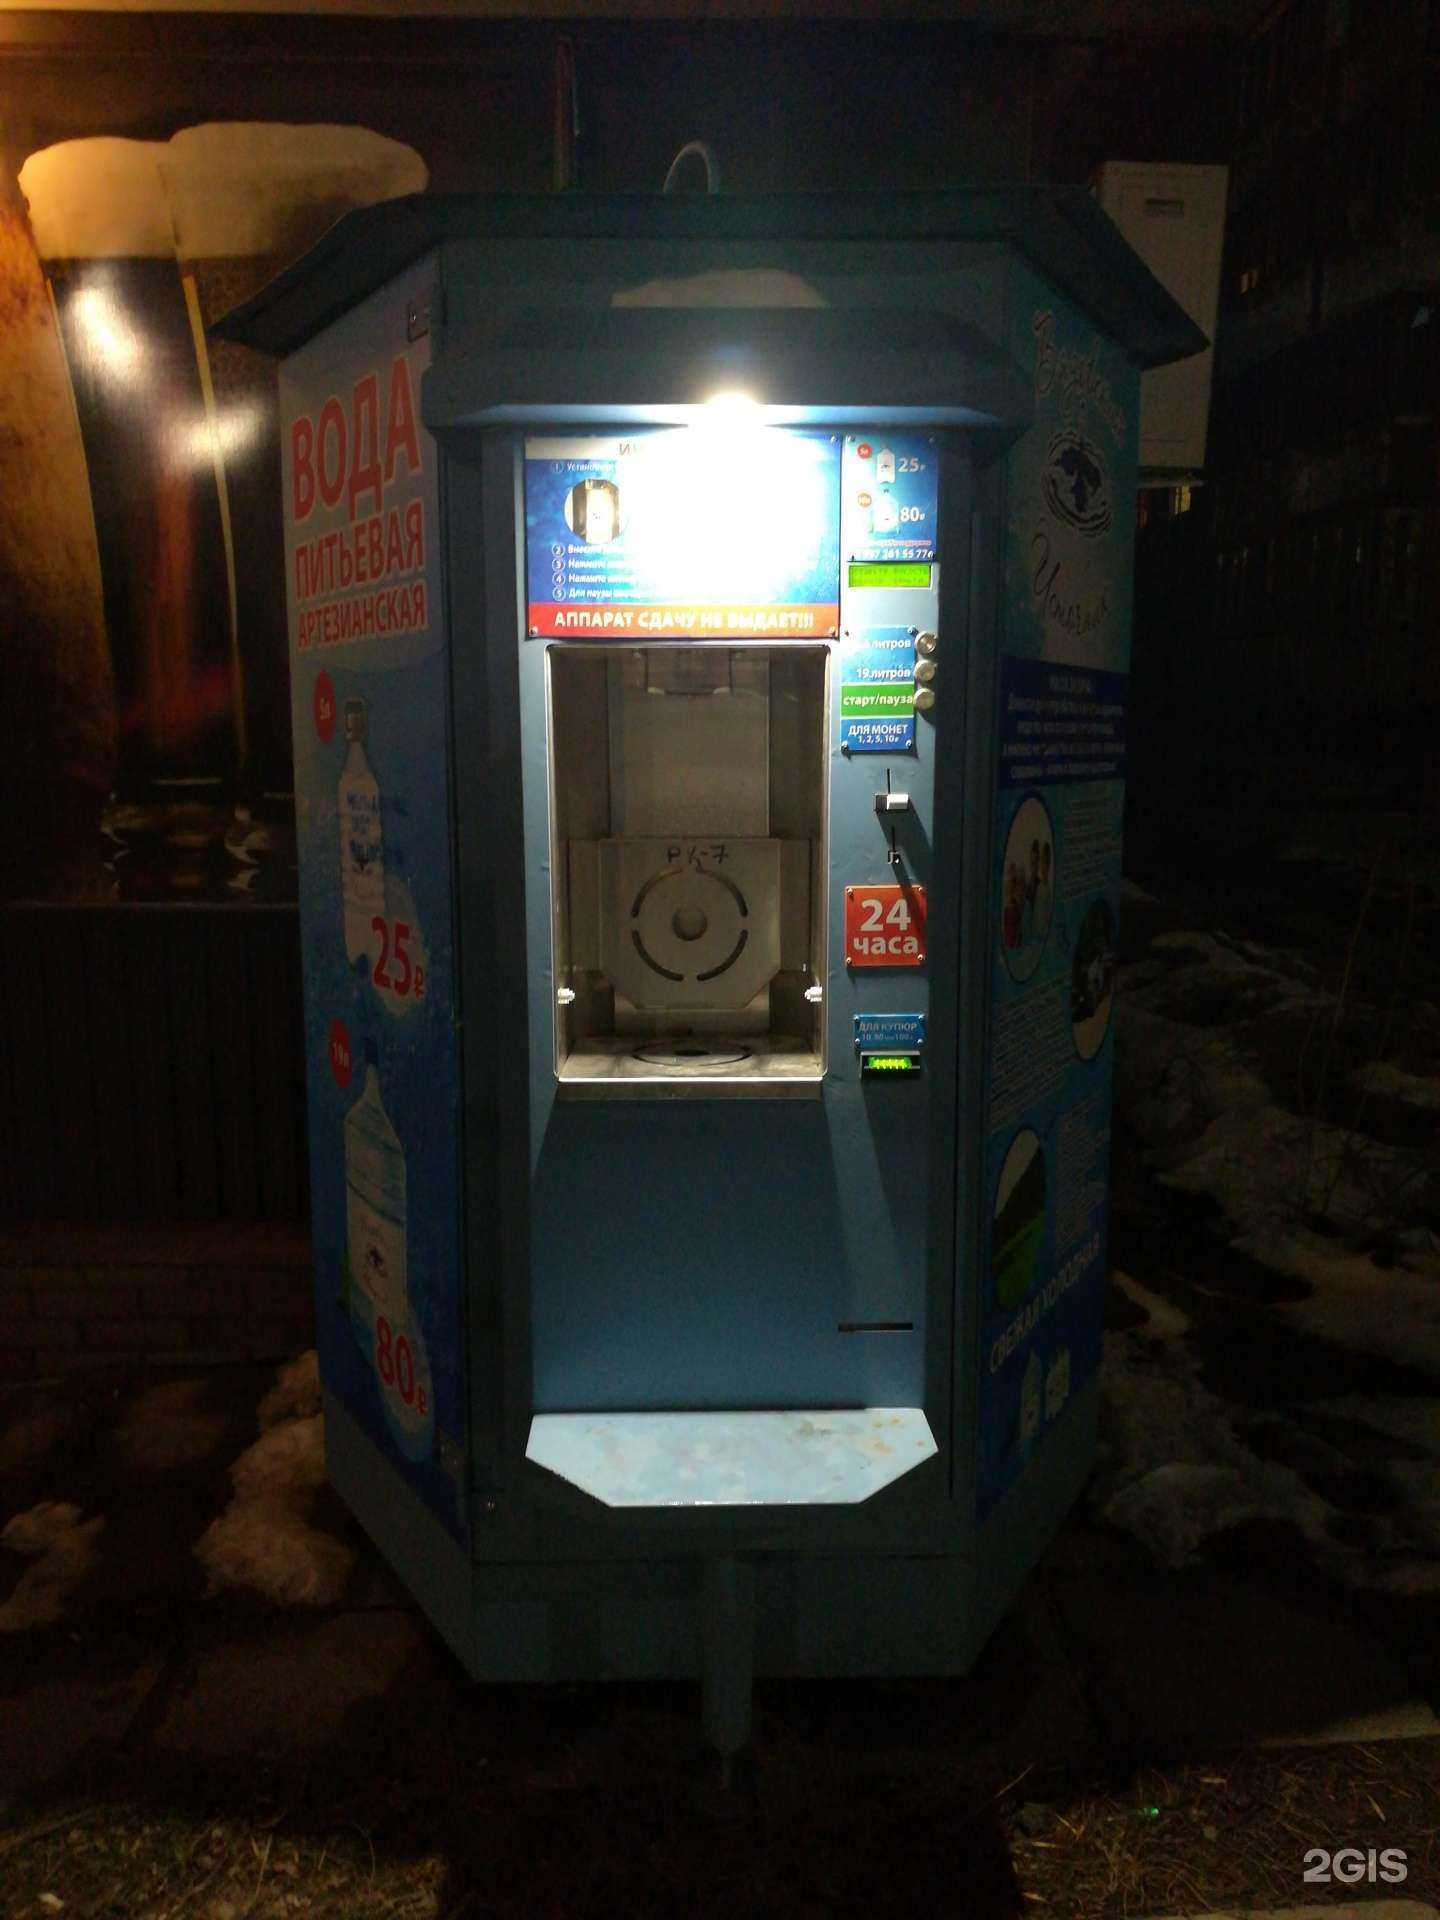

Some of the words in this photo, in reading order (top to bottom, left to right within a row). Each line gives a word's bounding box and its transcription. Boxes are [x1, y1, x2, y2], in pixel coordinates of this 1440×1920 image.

[292, 356, 420, 521] ВОДА
[296, 502, 423, 601] ПИТЬЕВАЯ
[299, 583, 425, 648] АРТЕЗИАНСКАЯ
[554, 611, 634, 627] АППАРАТ
[637, 611, 696, 630] СДАЧУ
[700, 612, 721, 628] НЕ
[871, 639, 912, 650] литров
[868, 668, 911, 680] литров
[843, 693, 913, 707] старт/пауза
[848, 725, 870, 737] ДЛЯ
[871, 724, 908, 735] МОНЕТ
[860, 898, 911, 932] 24
[853, 936, 919, 955] часа
